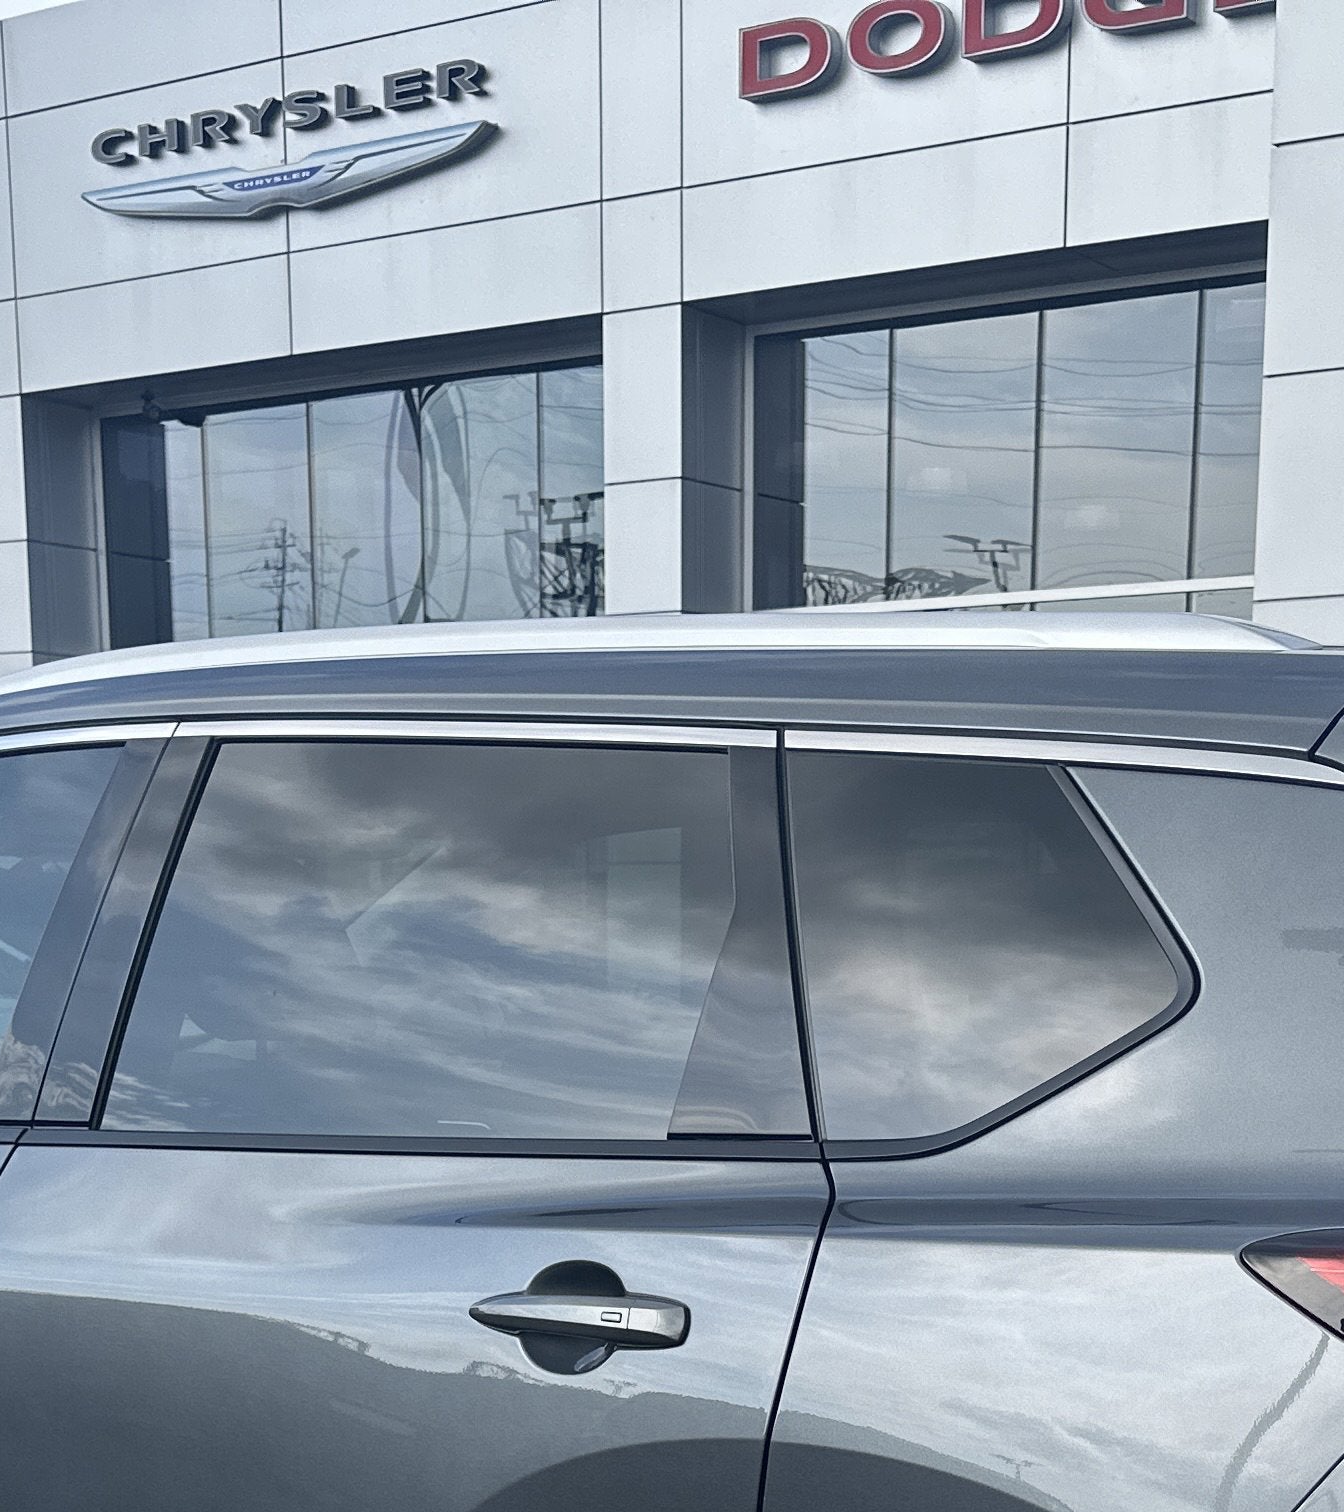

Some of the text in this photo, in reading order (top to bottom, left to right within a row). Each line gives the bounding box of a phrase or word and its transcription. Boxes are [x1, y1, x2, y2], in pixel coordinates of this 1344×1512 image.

[739, 0, 1276, 99] DOD
[91, 58, 486, 165] CHRYSLER
[234, 171, 311, 189] CHRYSLER
